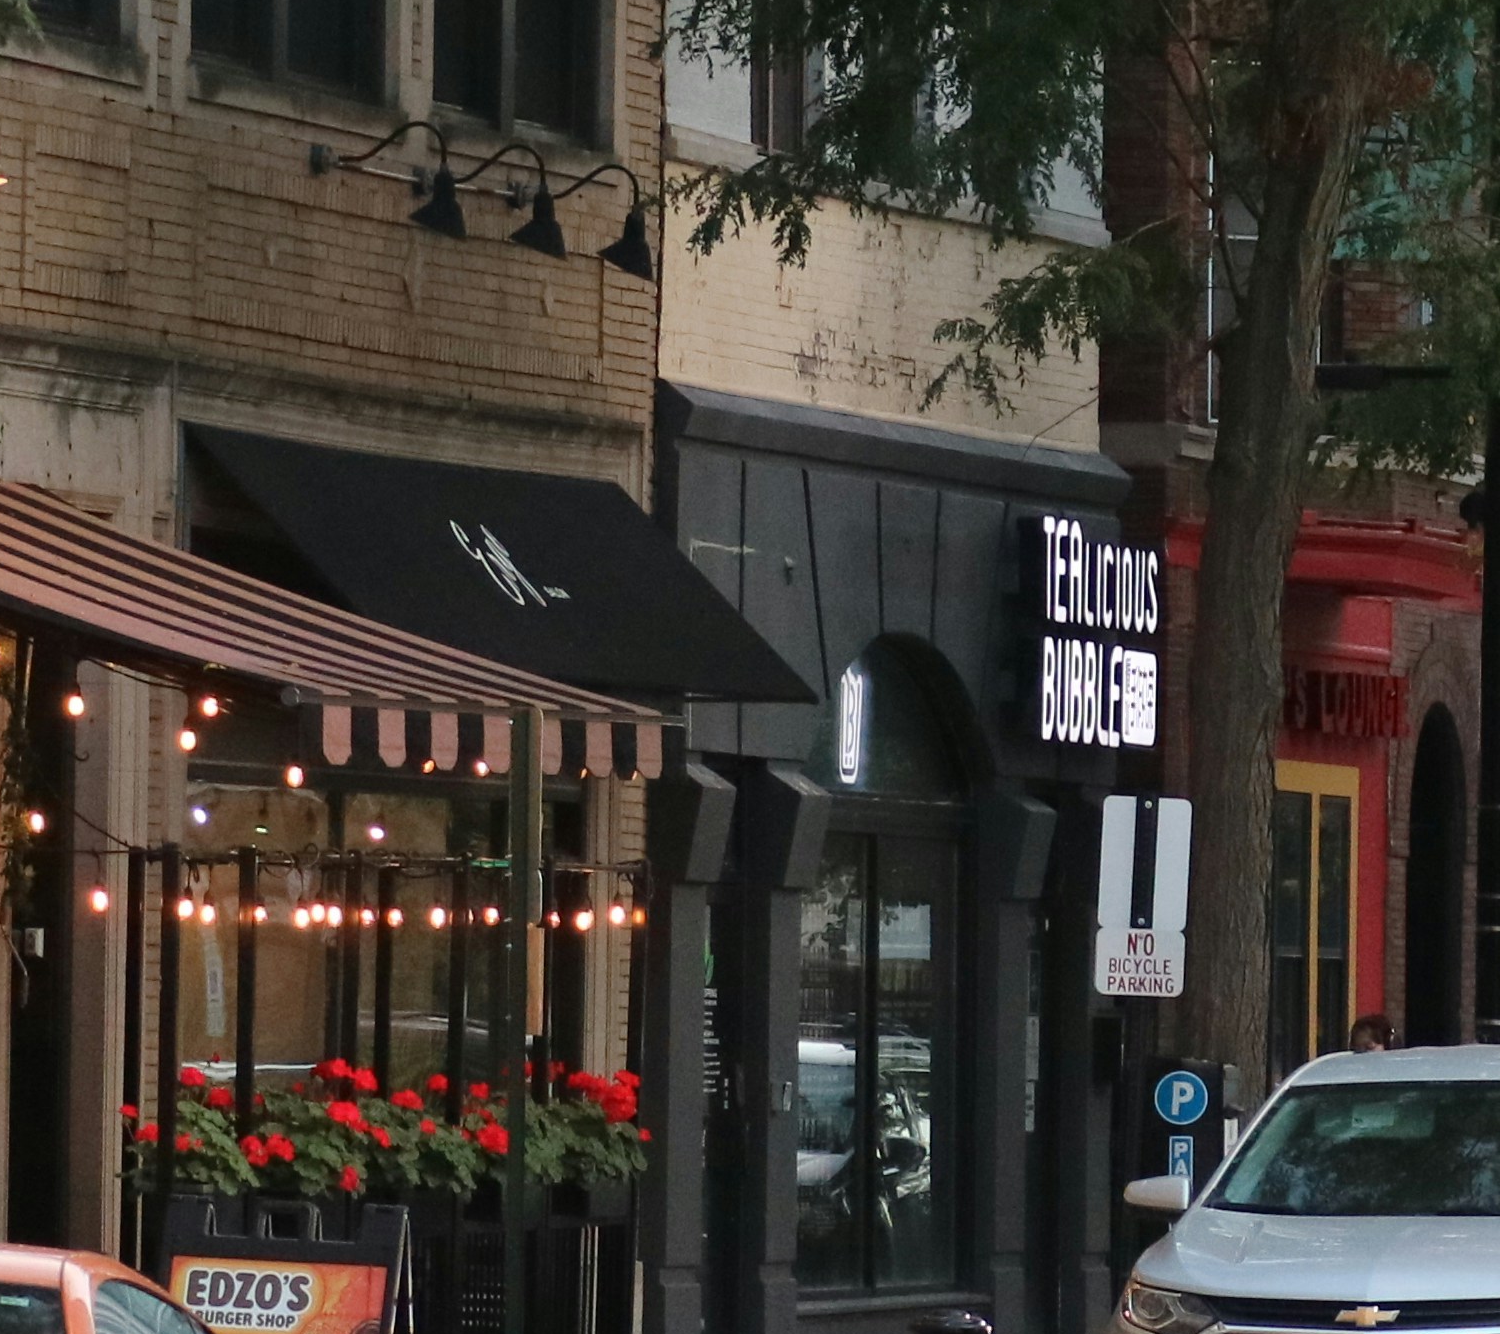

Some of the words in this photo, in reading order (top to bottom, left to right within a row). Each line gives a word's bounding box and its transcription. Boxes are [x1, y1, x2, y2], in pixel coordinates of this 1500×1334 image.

[1041, 636, 1124, 748] BUBBLE
[1127, 932, 1156, 956] NO
[1108, 957, 1172, 975] BICYCLE
[1106, 976, 1175, 994] PARKING
[1171, 1080, 1194, 1116] P
[1173, 1141, 1190, 1175] PA
[186, 1269, 311, 1312] EDZO'S
[256, 1314, 296, 1328] SHOP
